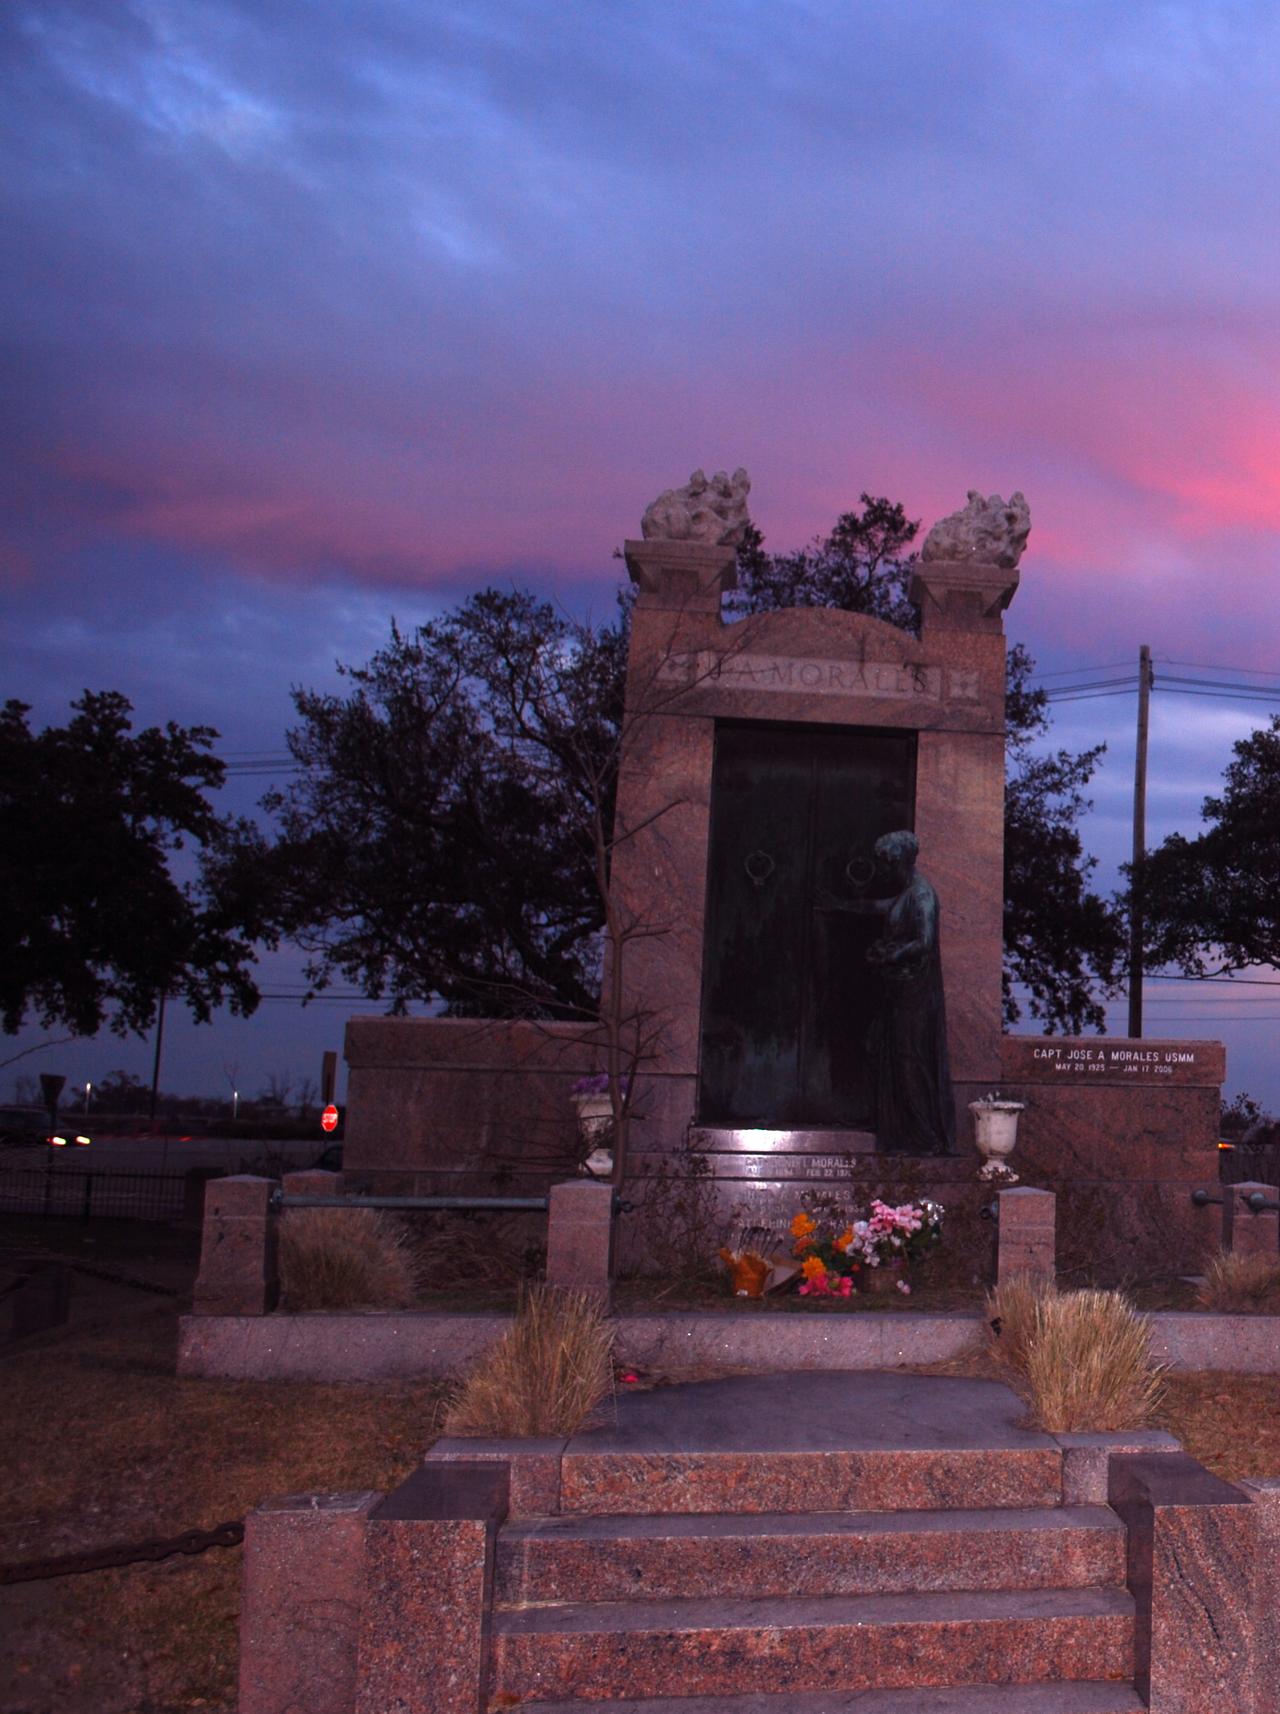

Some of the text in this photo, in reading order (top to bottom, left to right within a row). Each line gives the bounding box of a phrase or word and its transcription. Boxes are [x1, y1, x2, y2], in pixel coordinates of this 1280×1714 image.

[768, 661, 929, 693] MORALES
[1033, 1048, 1195, 1063] CAPT JOSE A MORALES USMM
[1055, 1063, 1071, 1071] MAY
[1123, 1065, 1138, 1073] JAN
[1142, 1065, 1150, 1073] 17
